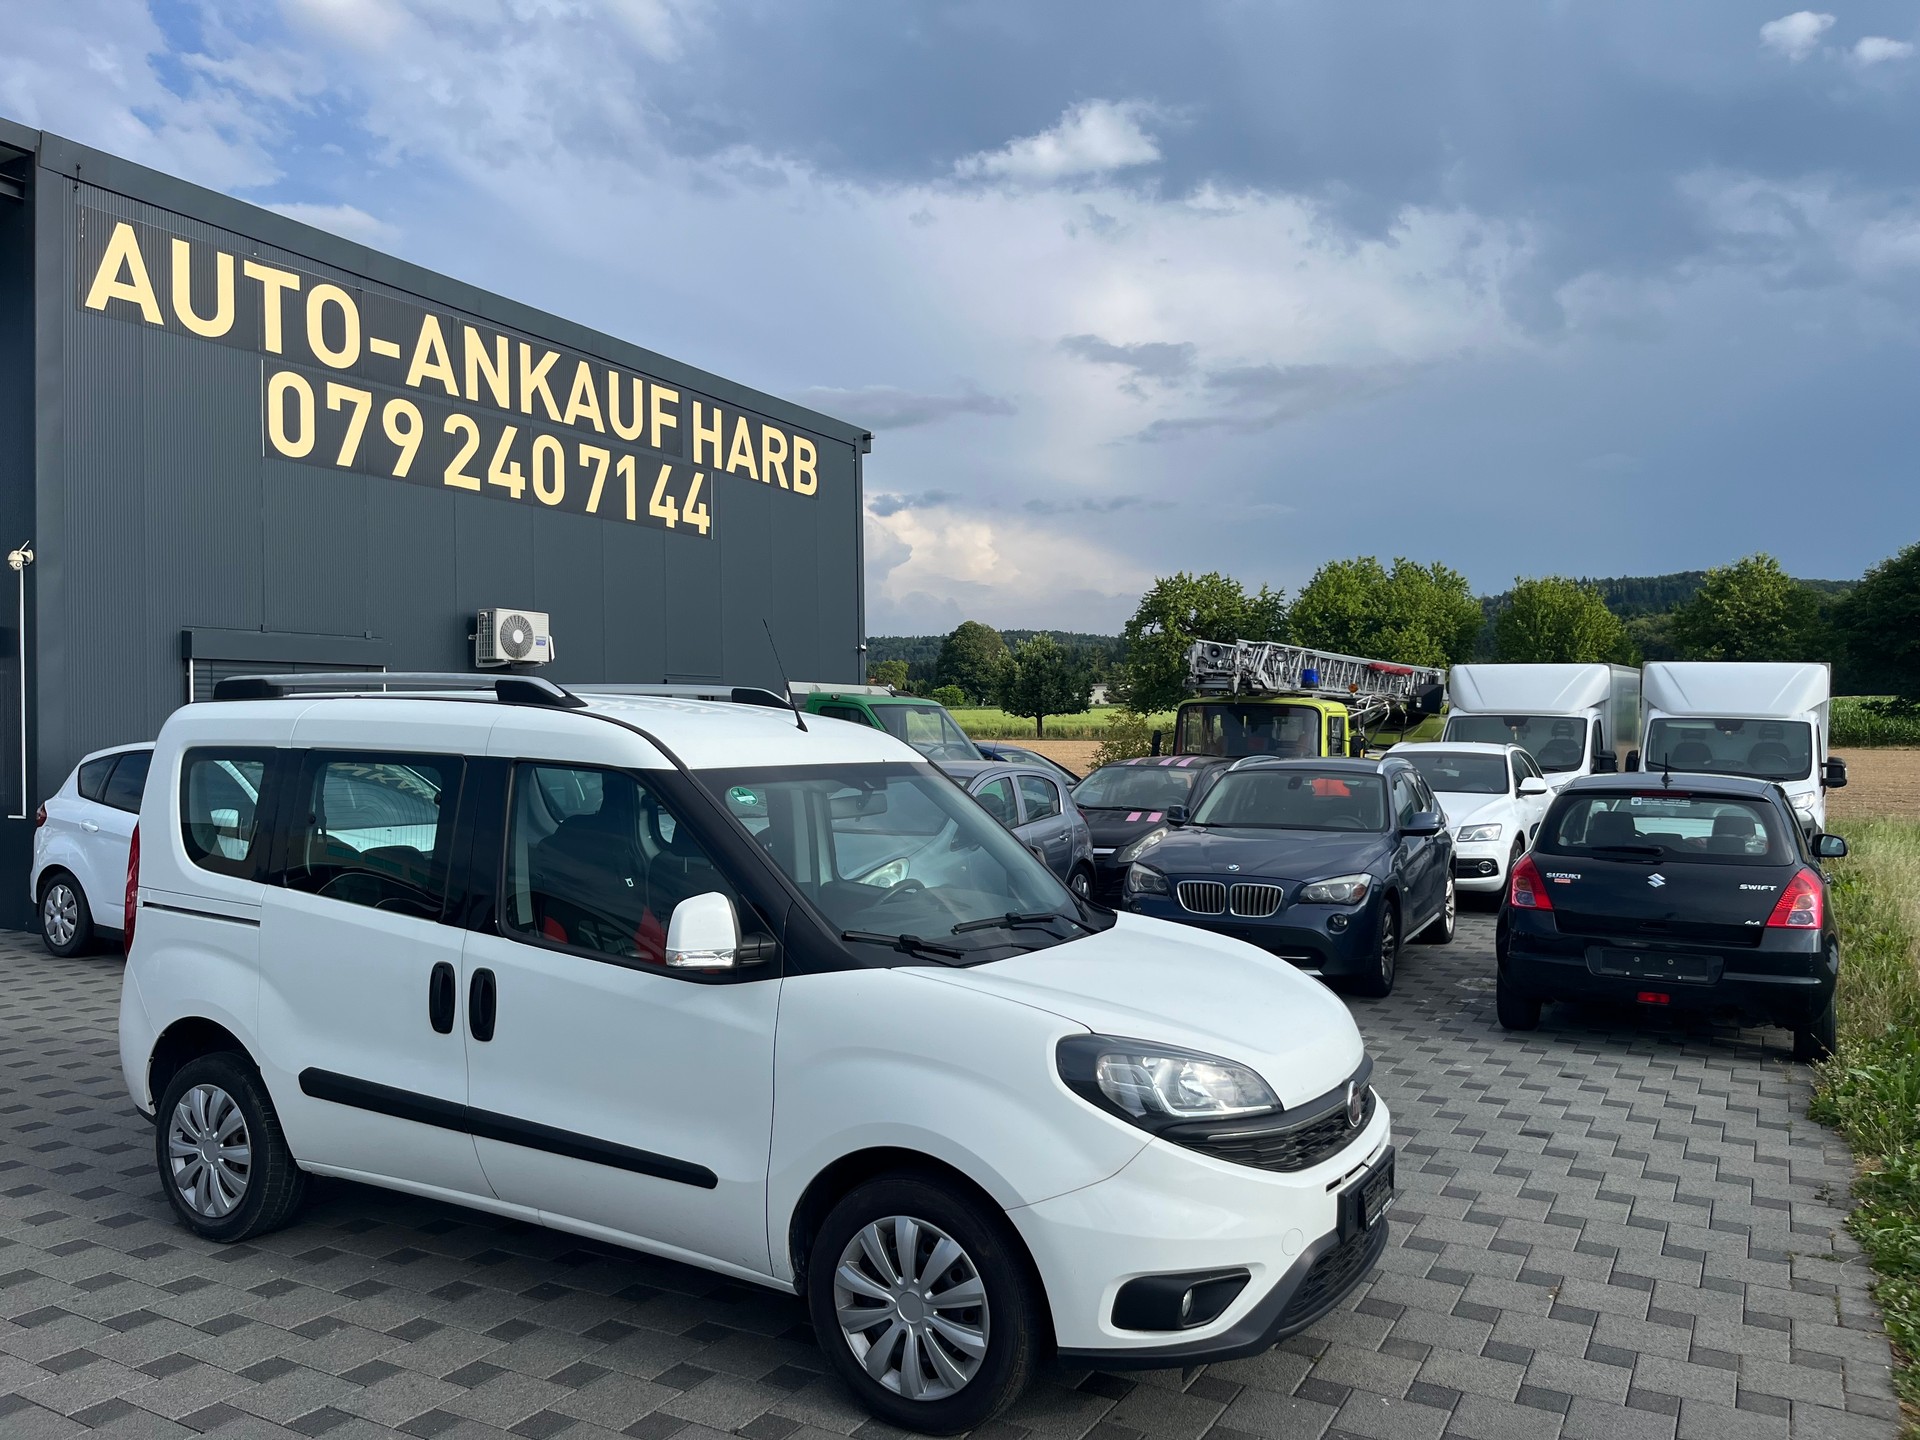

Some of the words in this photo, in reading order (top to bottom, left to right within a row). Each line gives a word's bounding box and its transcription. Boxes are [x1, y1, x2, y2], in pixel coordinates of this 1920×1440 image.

[85, 222, 680, 448] AUTO-ANKAUF
[692, 401, 818, 496] HARB
[268, 371, 424, 478] 079
[443, 413, 565, 506] 240
[1546, 872, 1581, 880] SUZUKI
[1739, 883, 1777, 891] SWIFT
